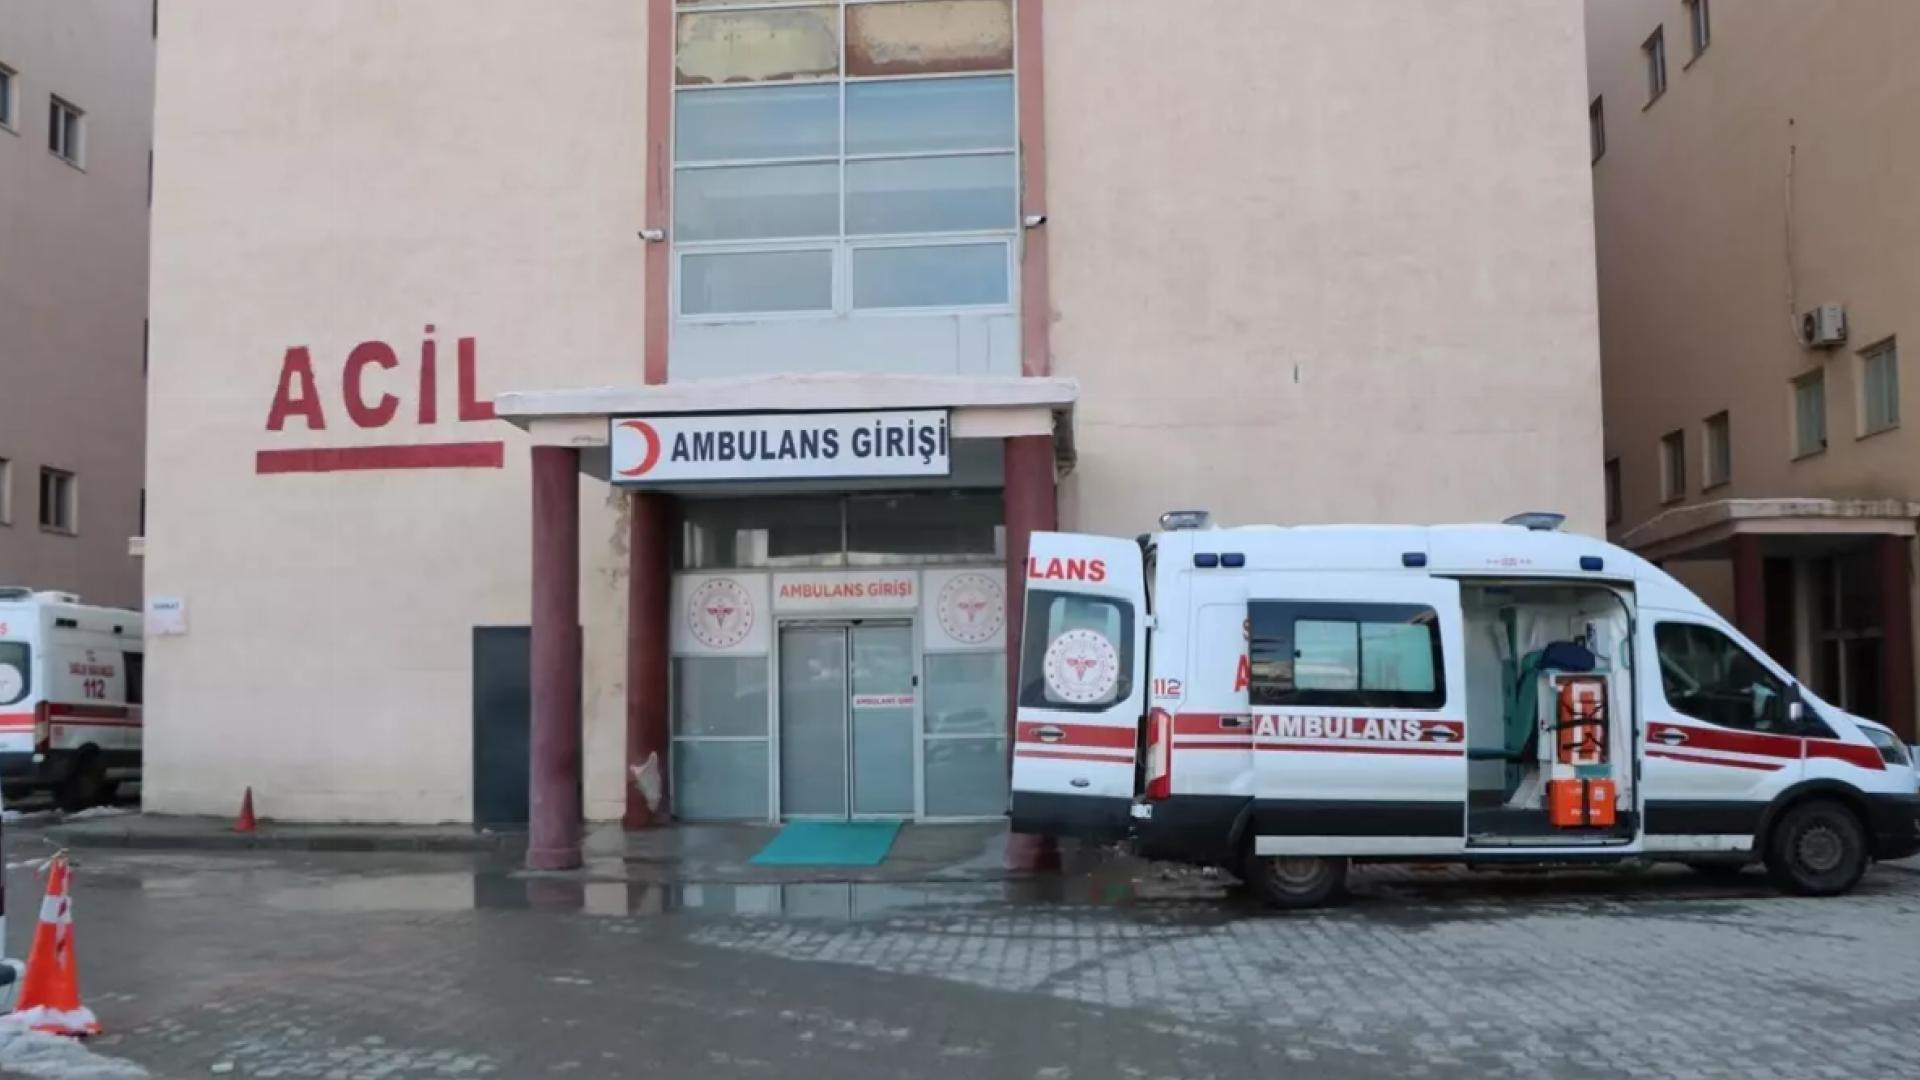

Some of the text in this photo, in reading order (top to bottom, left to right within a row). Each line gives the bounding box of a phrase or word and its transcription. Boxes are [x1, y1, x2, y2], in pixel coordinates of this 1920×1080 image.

[266, 324, 497, 431] ACİL
[670, 418, 946, 465] AMBULANS GİRİŞİ
[1028, 557, 1106, 582] LANS
[779, 578, 912, 598] AMBULANS GİRİŞİ
[83, 678, 106, 699] 112
[1153, 678, 1182, 696] 112
[1257, 714, 1422, 741] AMBULANS
